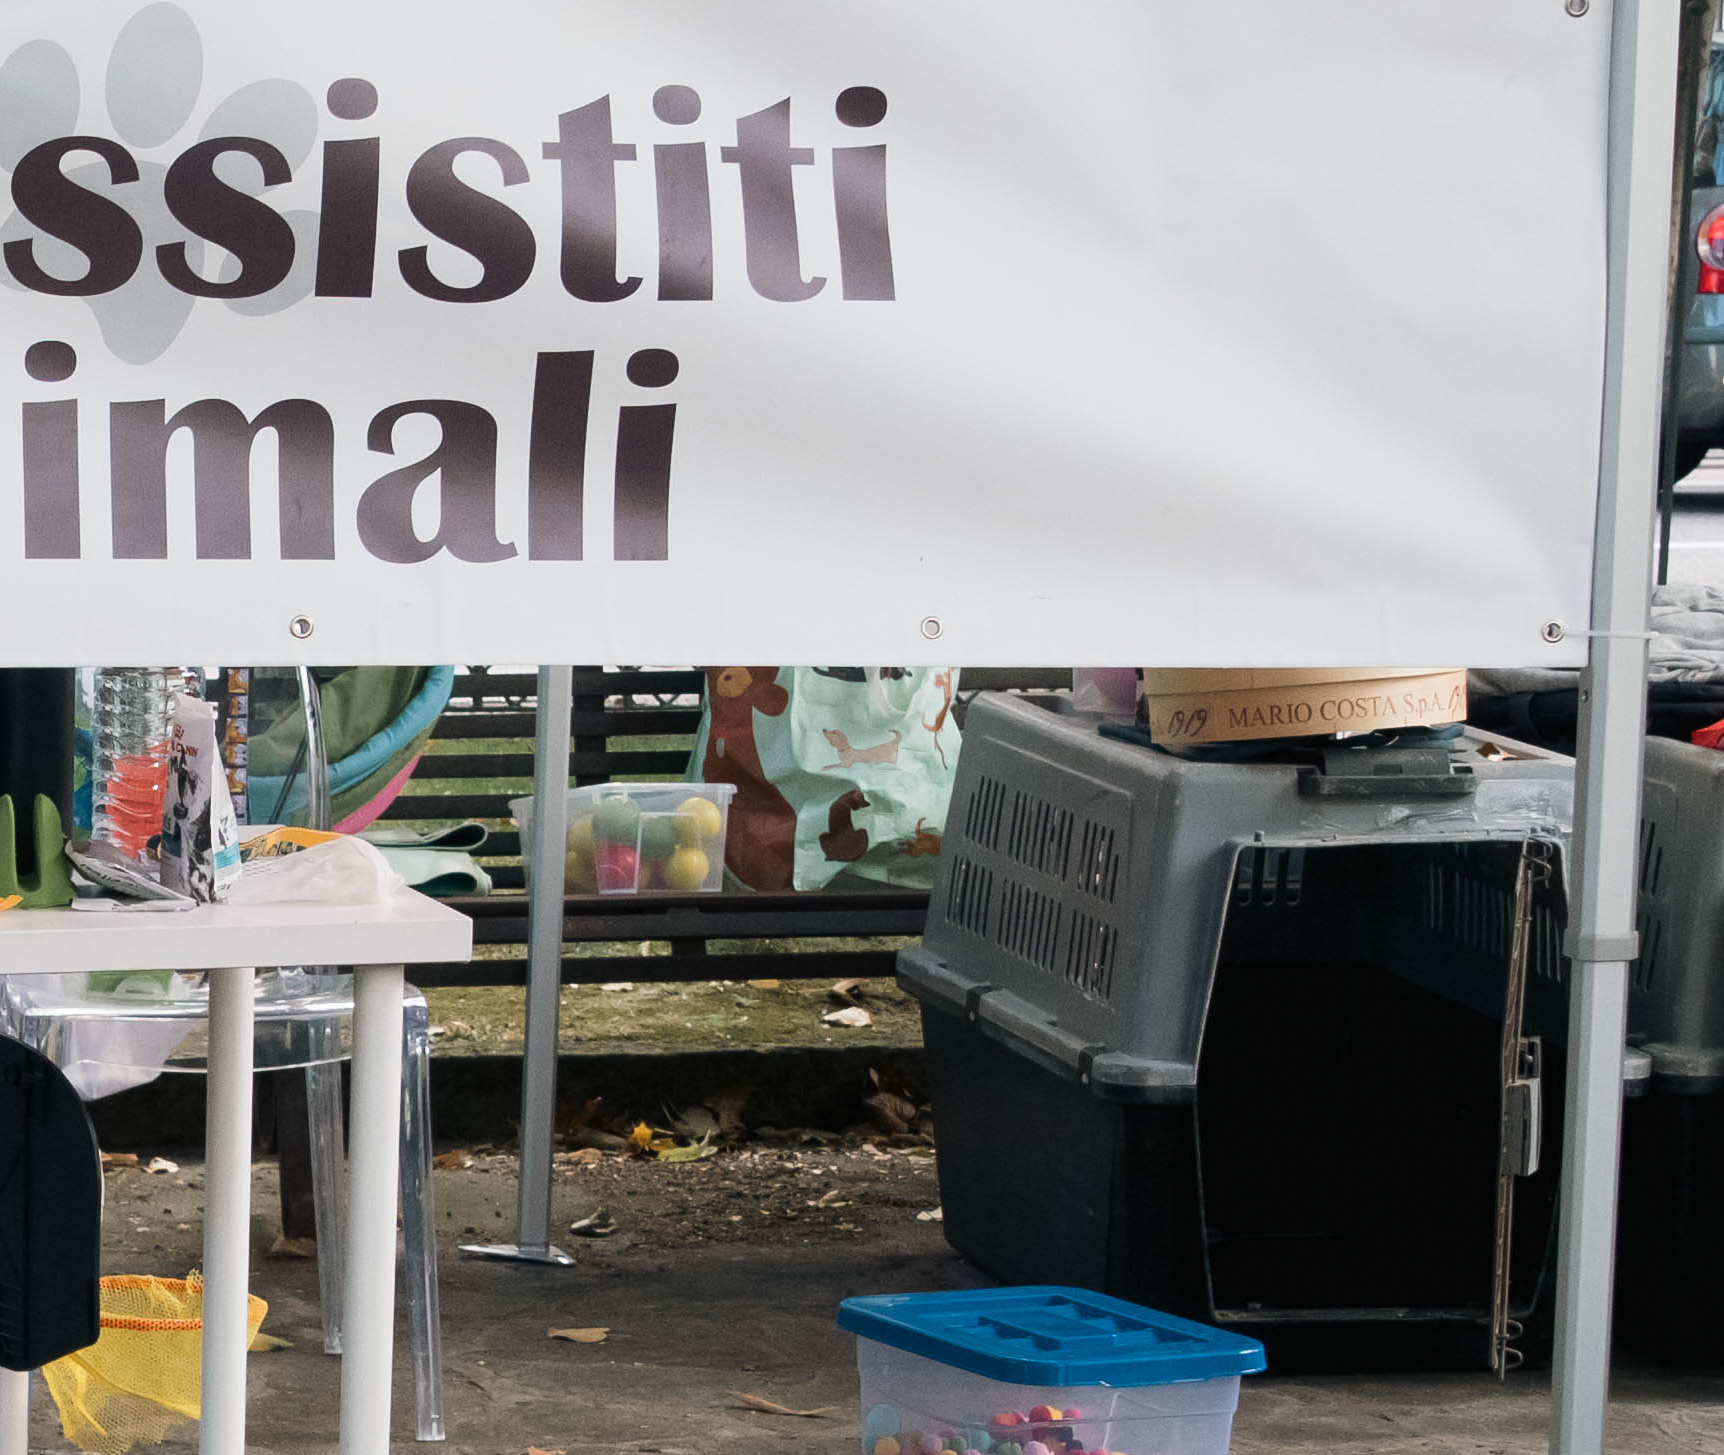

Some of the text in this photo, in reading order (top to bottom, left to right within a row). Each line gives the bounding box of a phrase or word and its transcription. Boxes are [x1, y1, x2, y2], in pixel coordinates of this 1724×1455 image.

[1227, 704, 1313, 730] MARIO
[1320, 694, 1398, 722] COSTA
[1403, 690, 1445, 719] S.p.A.
